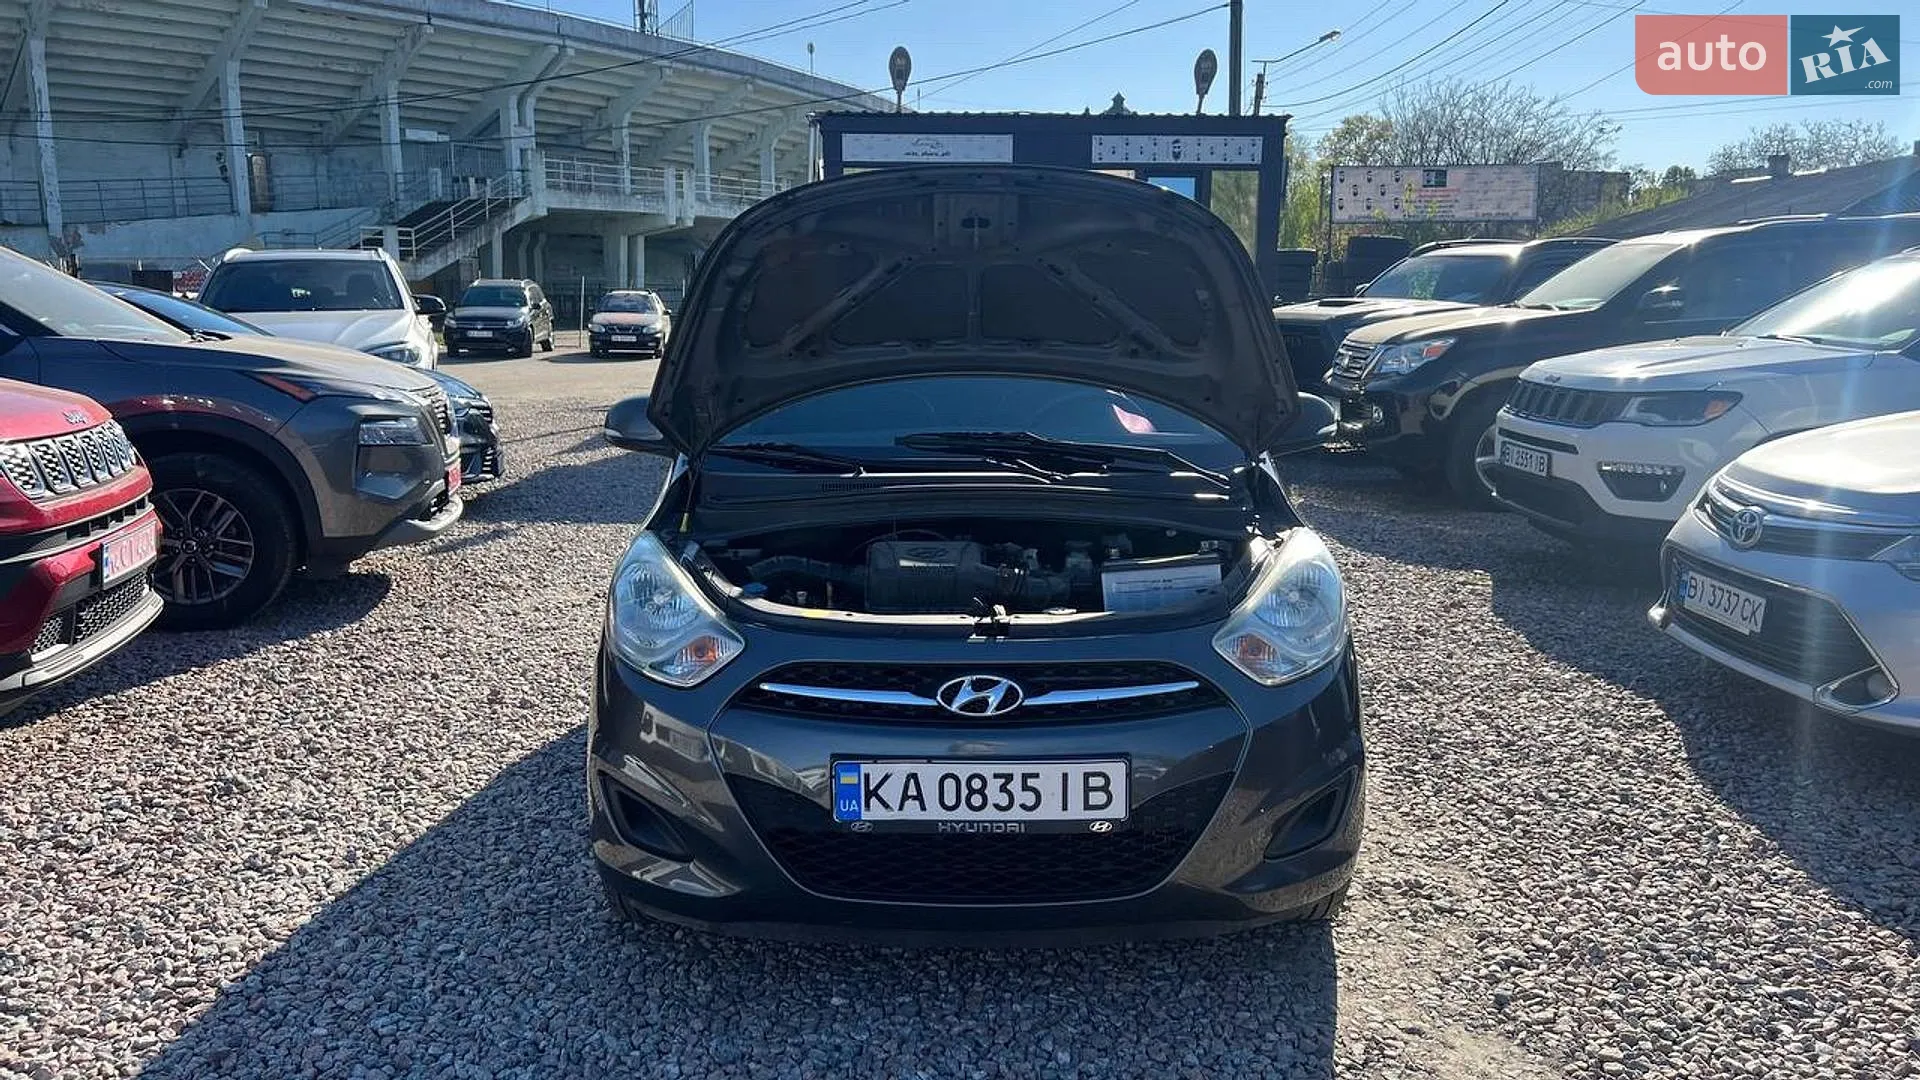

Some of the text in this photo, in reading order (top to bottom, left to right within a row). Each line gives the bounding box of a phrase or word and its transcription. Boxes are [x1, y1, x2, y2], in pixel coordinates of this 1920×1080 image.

[1687, 575, 1763, 627] BI 3737 CK
[862, 771, 1114, 812] KA 0835 IB
[840, 799, 860, 812] UA
[937, 821, 1026, 834] HYUNDAI
